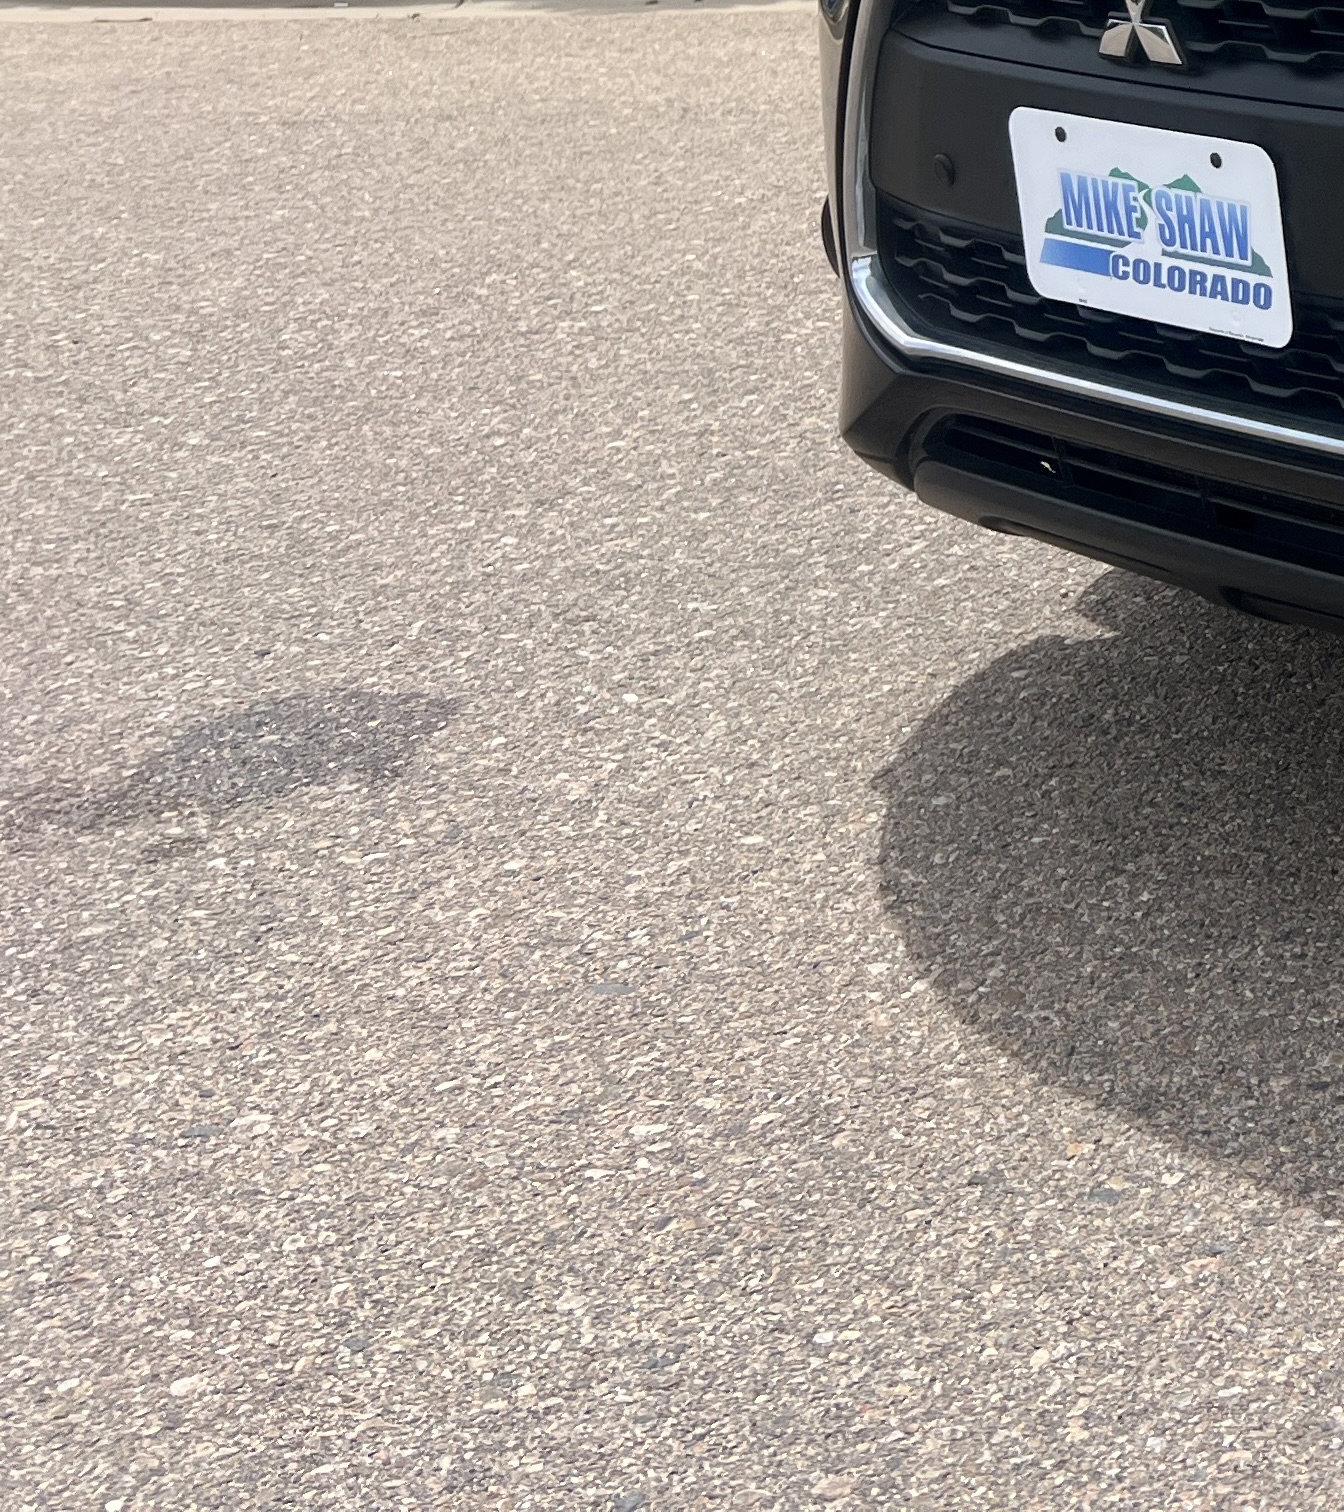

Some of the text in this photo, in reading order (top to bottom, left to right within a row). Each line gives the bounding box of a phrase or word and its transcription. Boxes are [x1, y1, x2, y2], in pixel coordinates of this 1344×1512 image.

[1059, 171, 1249, 262] MIKE SHAW
[1111, 254, 1273, 310] COLORADO
